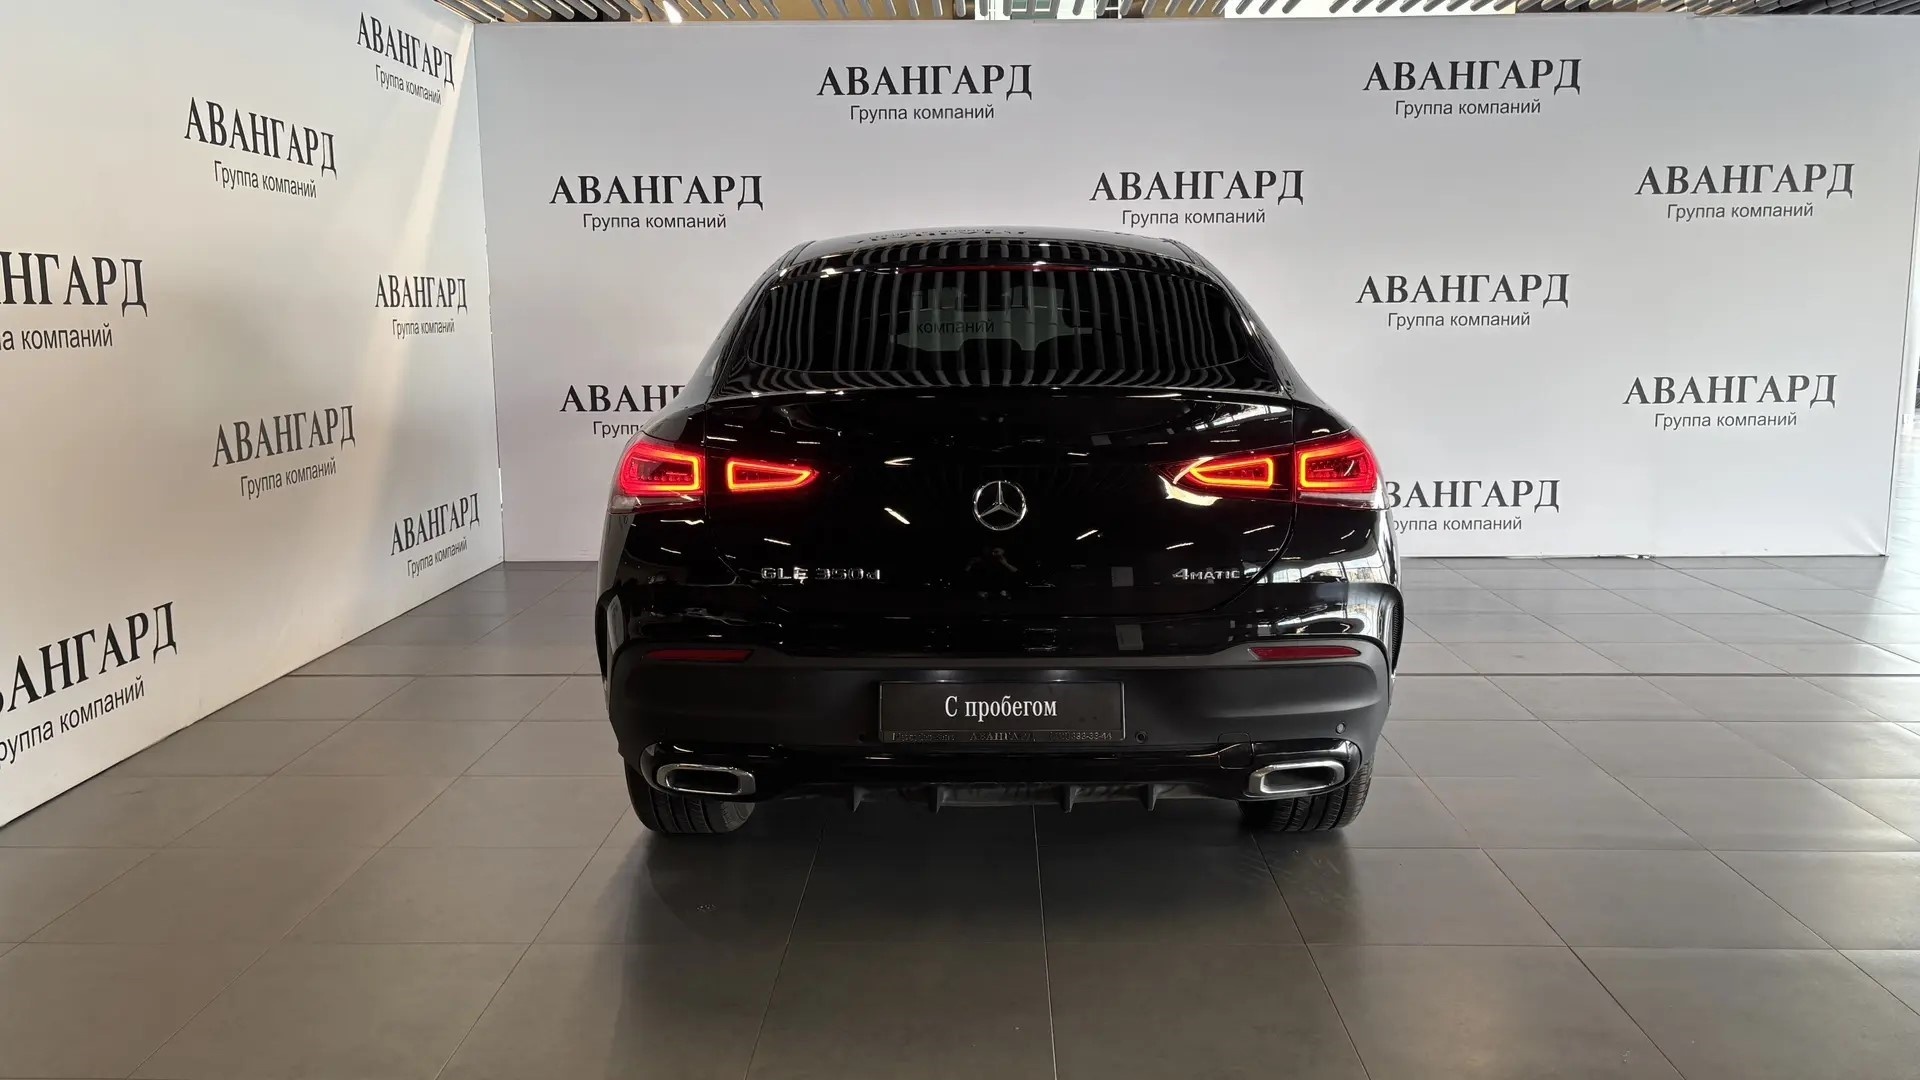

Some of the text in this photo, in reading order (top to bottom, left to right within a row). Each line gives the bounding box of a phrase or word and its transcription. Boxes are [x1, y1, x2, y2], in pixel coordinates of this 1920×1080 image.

[357, 11, 455, 92] АВАНГАРД
[376, 64, 442, 105] Группа компаний
[817, 65, 1031, 100] АВАНГАРД
[1363, 59, 1581, 95] АВАНГАРД
[851, 104, 993, 123] Группа компаний
[1396, 99, 1540, 118] Группа компаний
[184, 96, 337, 181] АВАНГАРД
[214, 160, 317, 199] Группа компаний
[550, 176, 763, 210] АВАНГАРД
[1089, 170, 1303, 205] АВАНГАРД
[1635, 164, 1855, 200] АВАНГАРД
[583, 212, 727, 231] Группа компаний
[1123, 209, 1265, 228] Группа компаний
[1668, 203, 1813, 221] Группа компаний
[0, 251, 148, 318] НГАРД
[375, 274, 468, 314] АВАНГАРД
[1355, 274, 1569, 308] АВАНГАРД
[21, 322, 113, 350] компаний
[392, 319, 455, 338] Группа компаний
[1388, 311, 1530, 328] Группа компаний
[1622, 375, 1838, 408] АВАНГАРД
[212, 405, 356, 468] АВАНГАРД
[593, 421, 643, 438] Групп
[1655, 412, 1797, 430] Группа компаний
[240, 456, 337, 500] Группа компаний
[391, 493, 480, 556] АВАНГАРД
[1443, 516, 1522, 531] компаний
[407, 536, 468, 579] Группа компаний
[761, 566, 881, 581] GLE 350d
[1172, 568, 1241, 580] 4MATIC
[60, 675, 145, 733] компаний
[945, 695, 1058, 722] С пробегом
